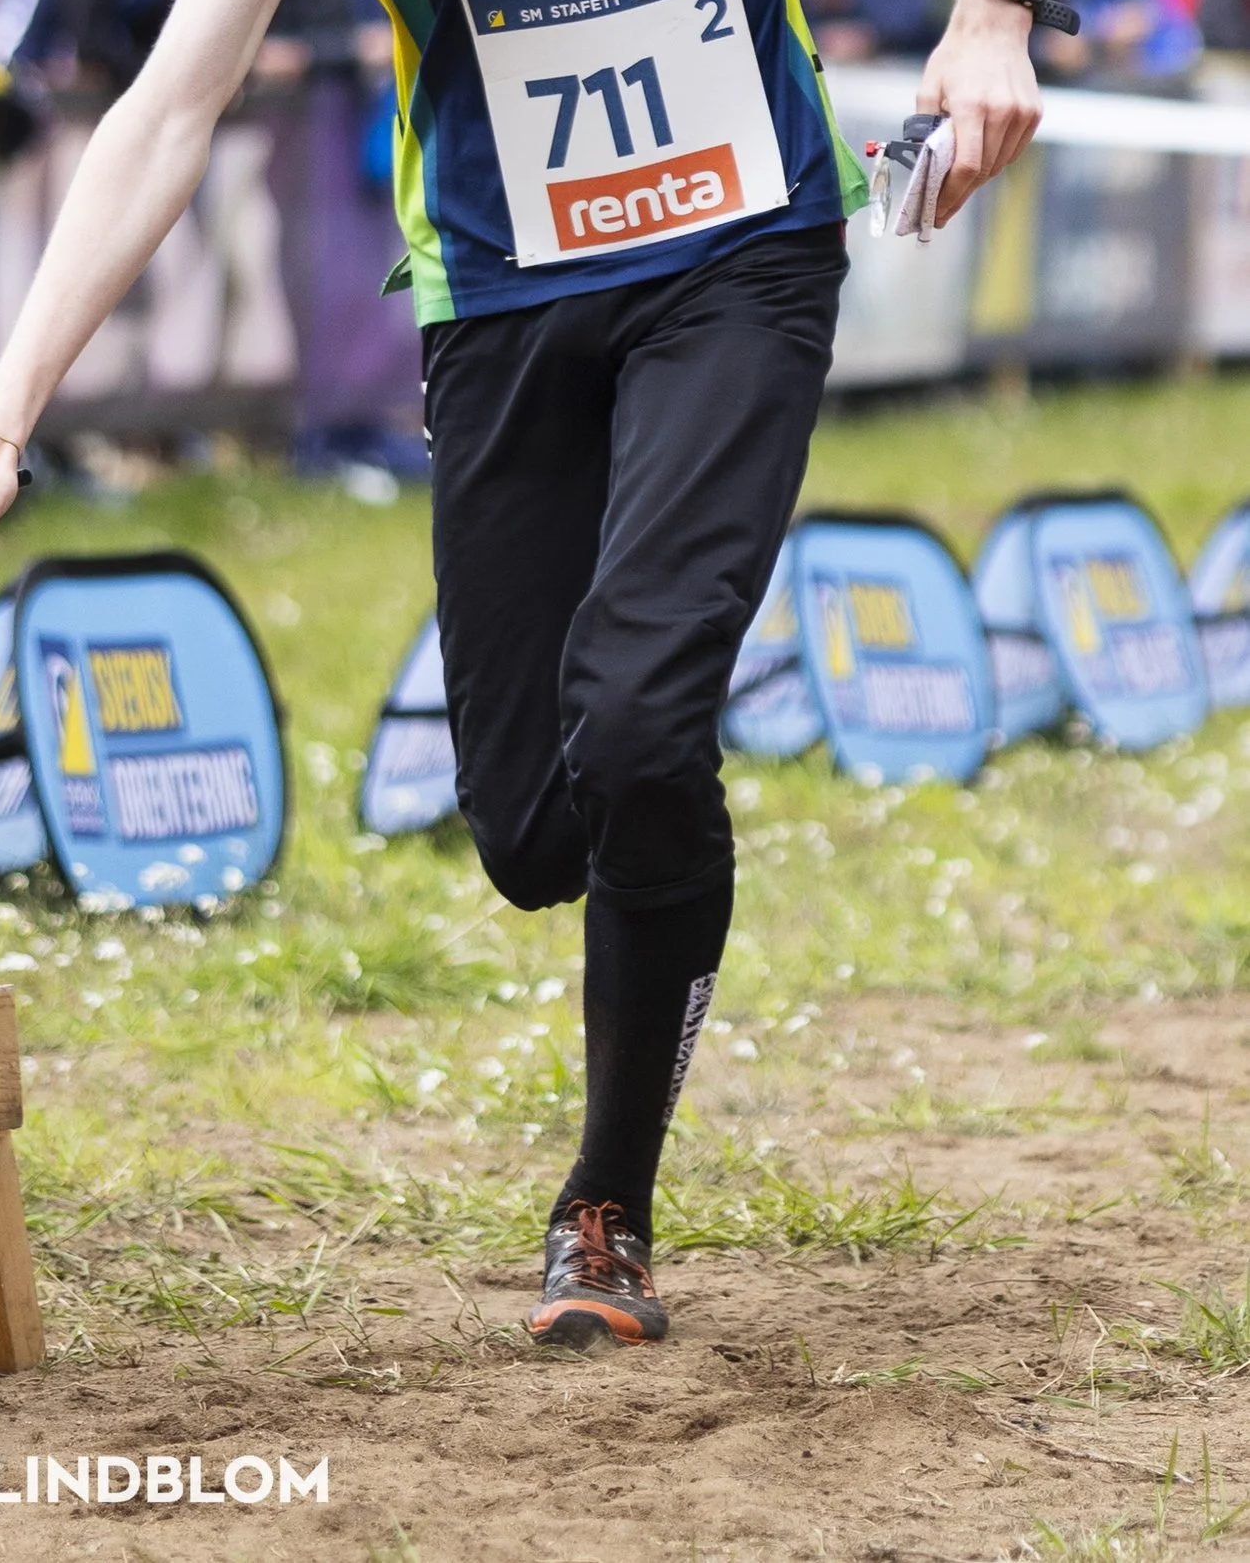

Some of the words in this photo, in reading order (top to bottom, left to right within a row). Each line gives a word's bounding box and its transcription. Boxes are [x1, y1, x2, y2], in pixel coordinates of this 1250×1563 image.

[520, 8, 544, 24] SM
[524, 55, 675, 170] 711
[569, 170, 726, 238] renta
